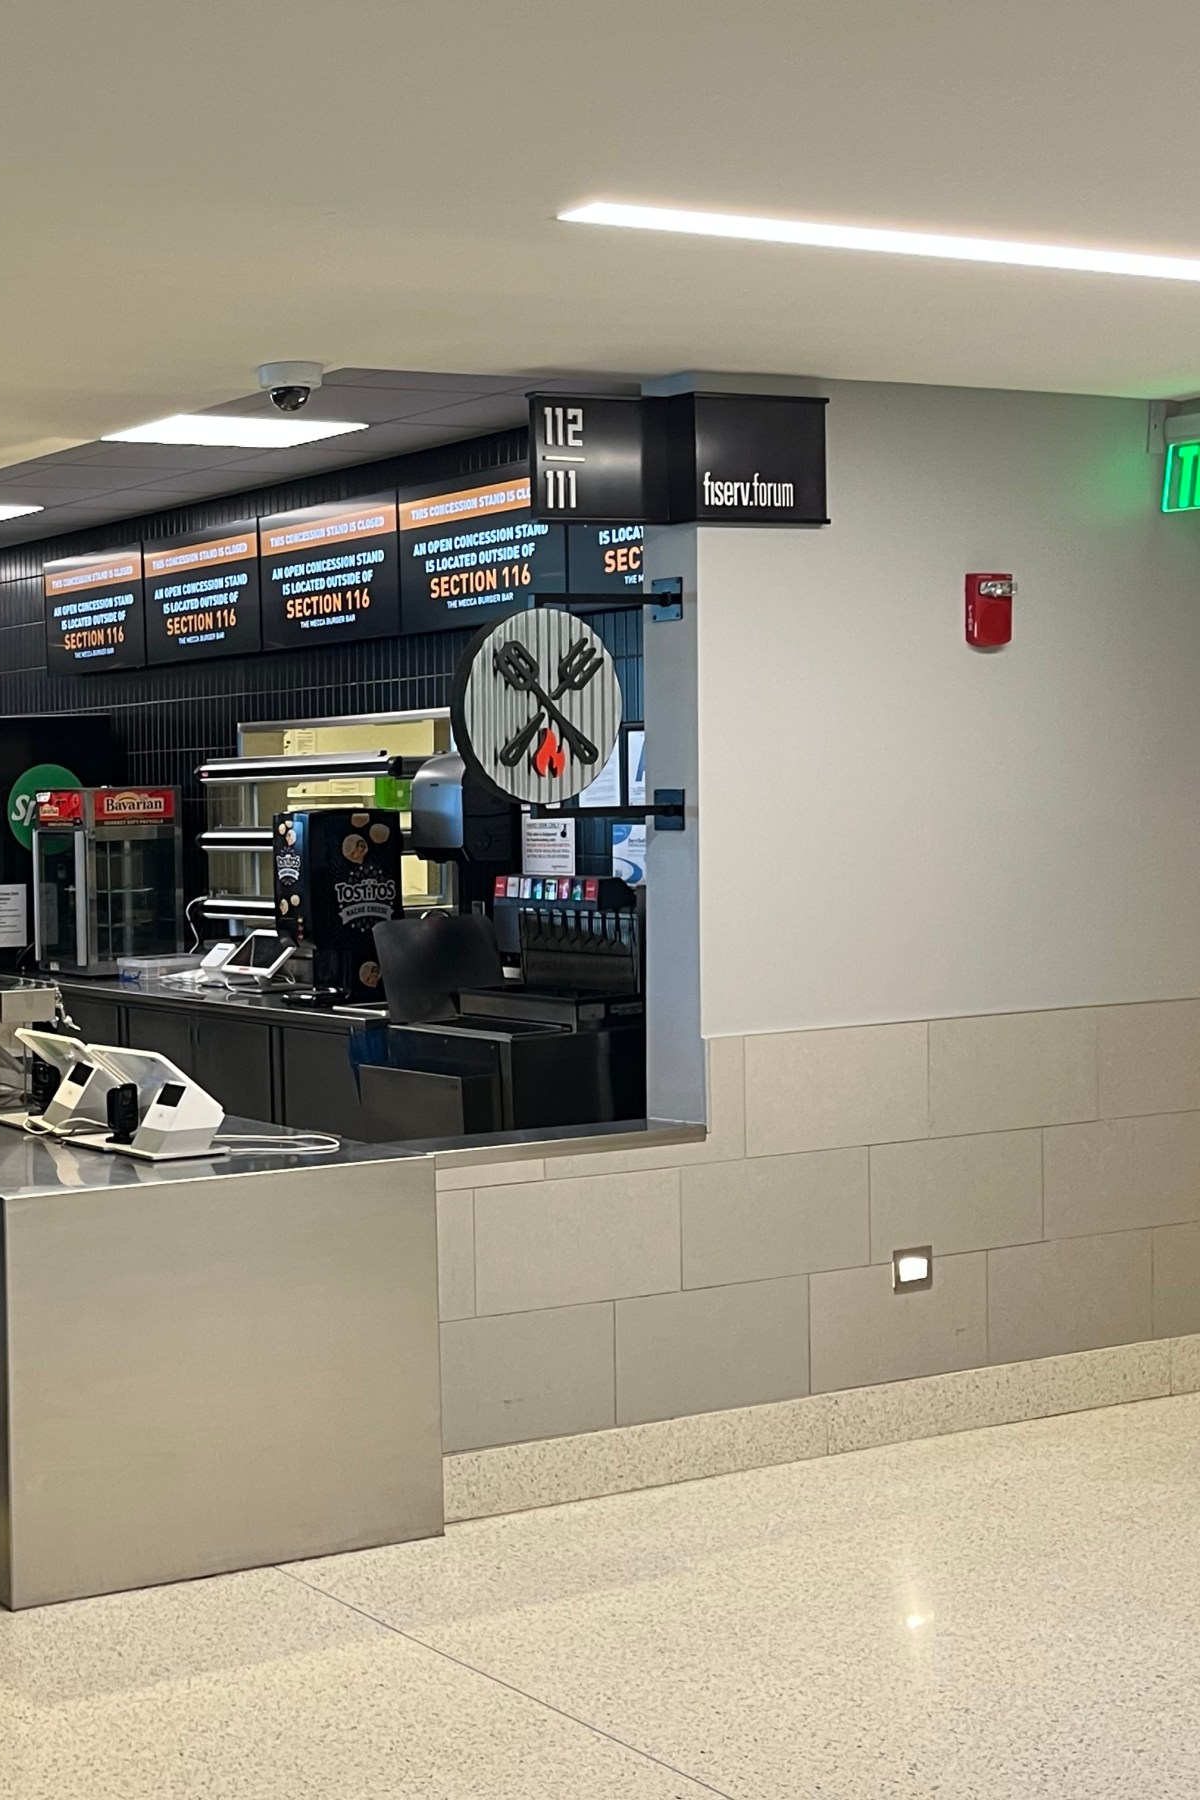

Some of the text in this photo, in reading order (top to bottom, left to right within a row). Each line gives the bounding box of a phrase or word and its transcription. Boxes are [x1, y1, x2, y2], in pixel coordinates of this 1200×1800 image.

[544, 406, 584, 446] 112
[411, 487, 531, 520] THIS CONCESSION STAND IS CLO
[545, 470, 577, 509] 111
[703, 471, 794, 507] fiserv.forum
[413, 524, 549, 557] AN OPEN CONCESSION STAND
[599, 530, 610, 545] IS
[272, 549, 385, 581] AN OPEN CONCESSION STAND
[425, 542, 536, 573] IS LOCATED OUTSIDE OF
[154, 573, 248, 600] AN OPEN CONCESSION STAND
[282, 569, 374, 595] IS LOCATED OUTSIDE OF
[430, 563, 531, 599] SECTION 116
[163, 591, 239, 614] IS LOCATED OUTSIDE OF
[286, 588, 370, 619] SECTION 116
[166, 608, 237, 636] SECTION 116
[106, 797, 163, 812] Bavarian
